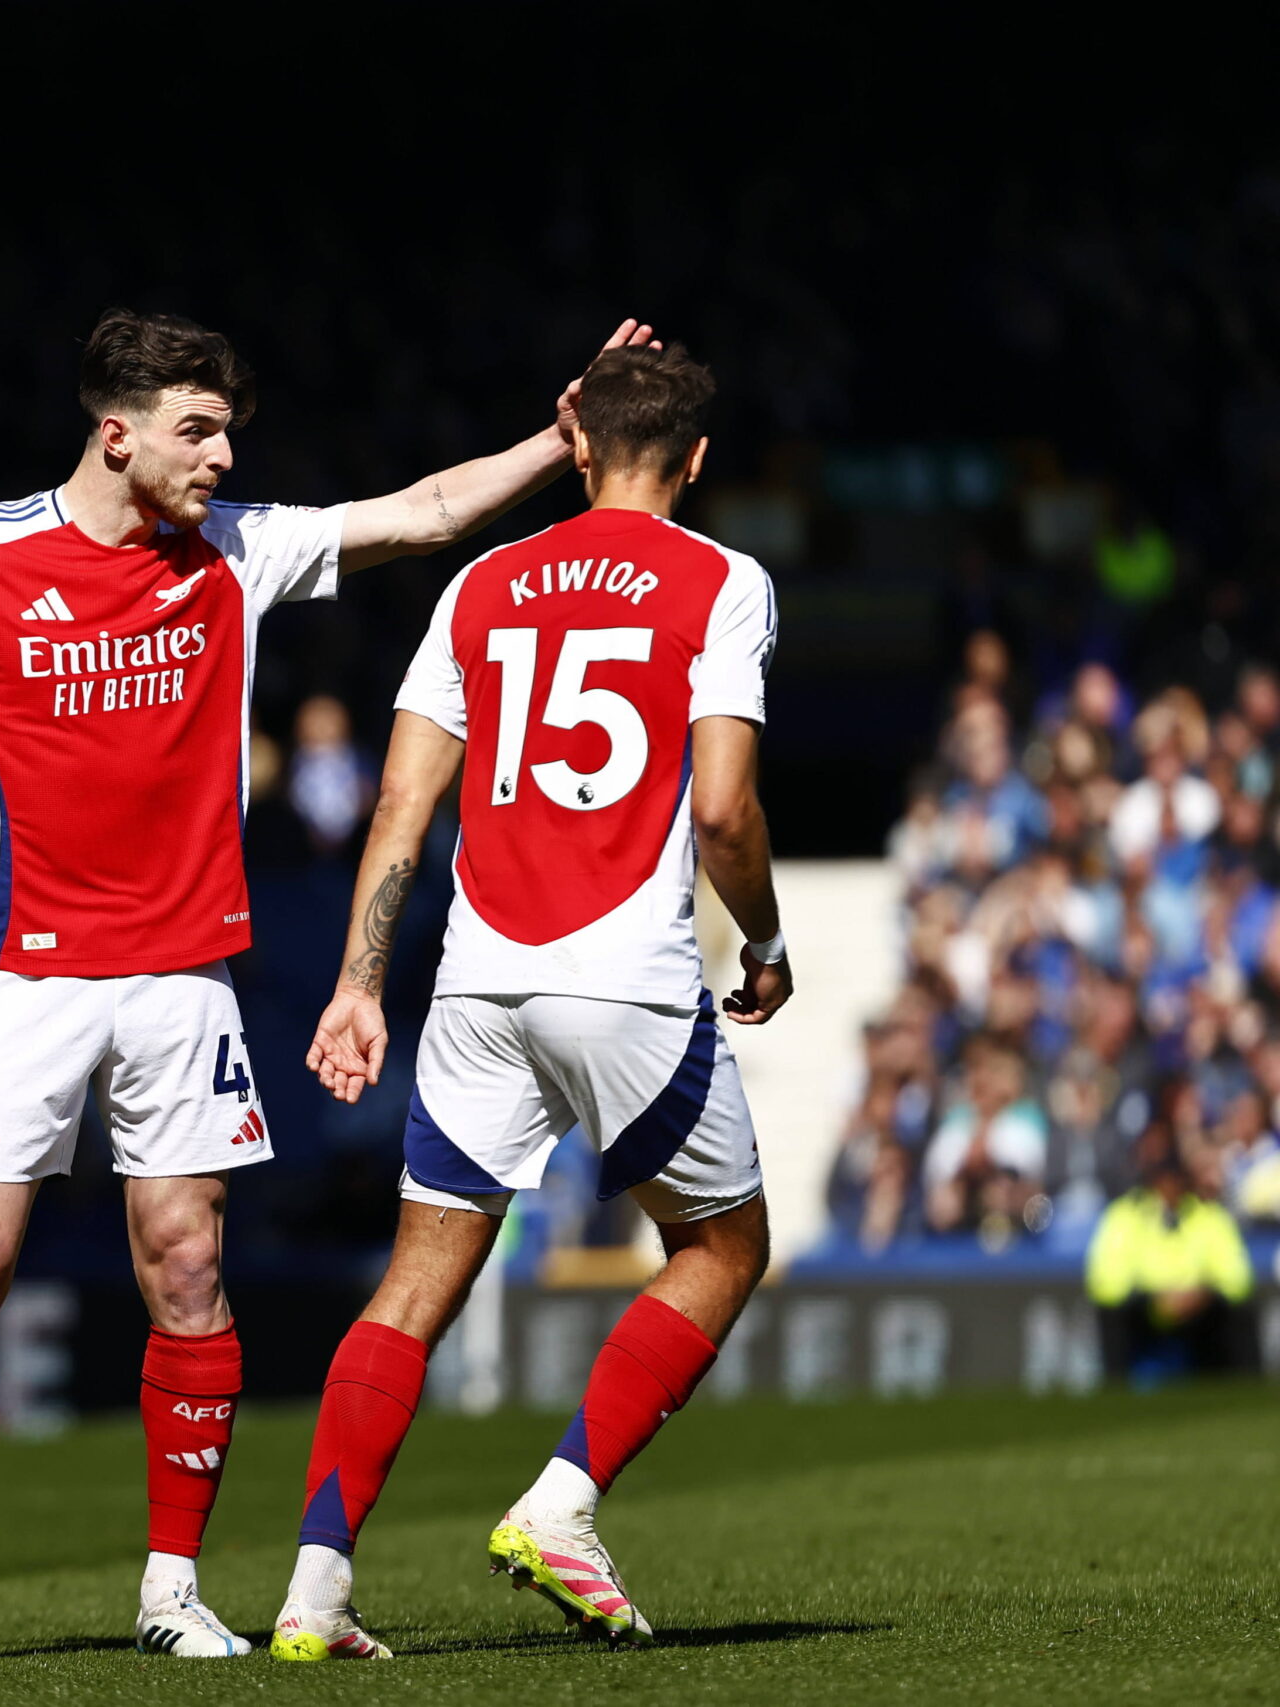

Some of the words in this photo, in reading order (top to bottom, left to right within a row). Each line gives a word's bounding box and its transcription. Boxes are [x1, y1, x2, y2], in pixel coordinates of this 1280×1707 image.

[509, 558, 659, 606] KIWIOR
[18, 622, 207, 679] Emirates
[53, 679, 95, 717] FLY
[102, 668, 185, 713] BETTER
[486, 626, 655, 812] 15
[213, 1030, 258, 1101] 4
[172, 1402, 232, 1422] AFC
